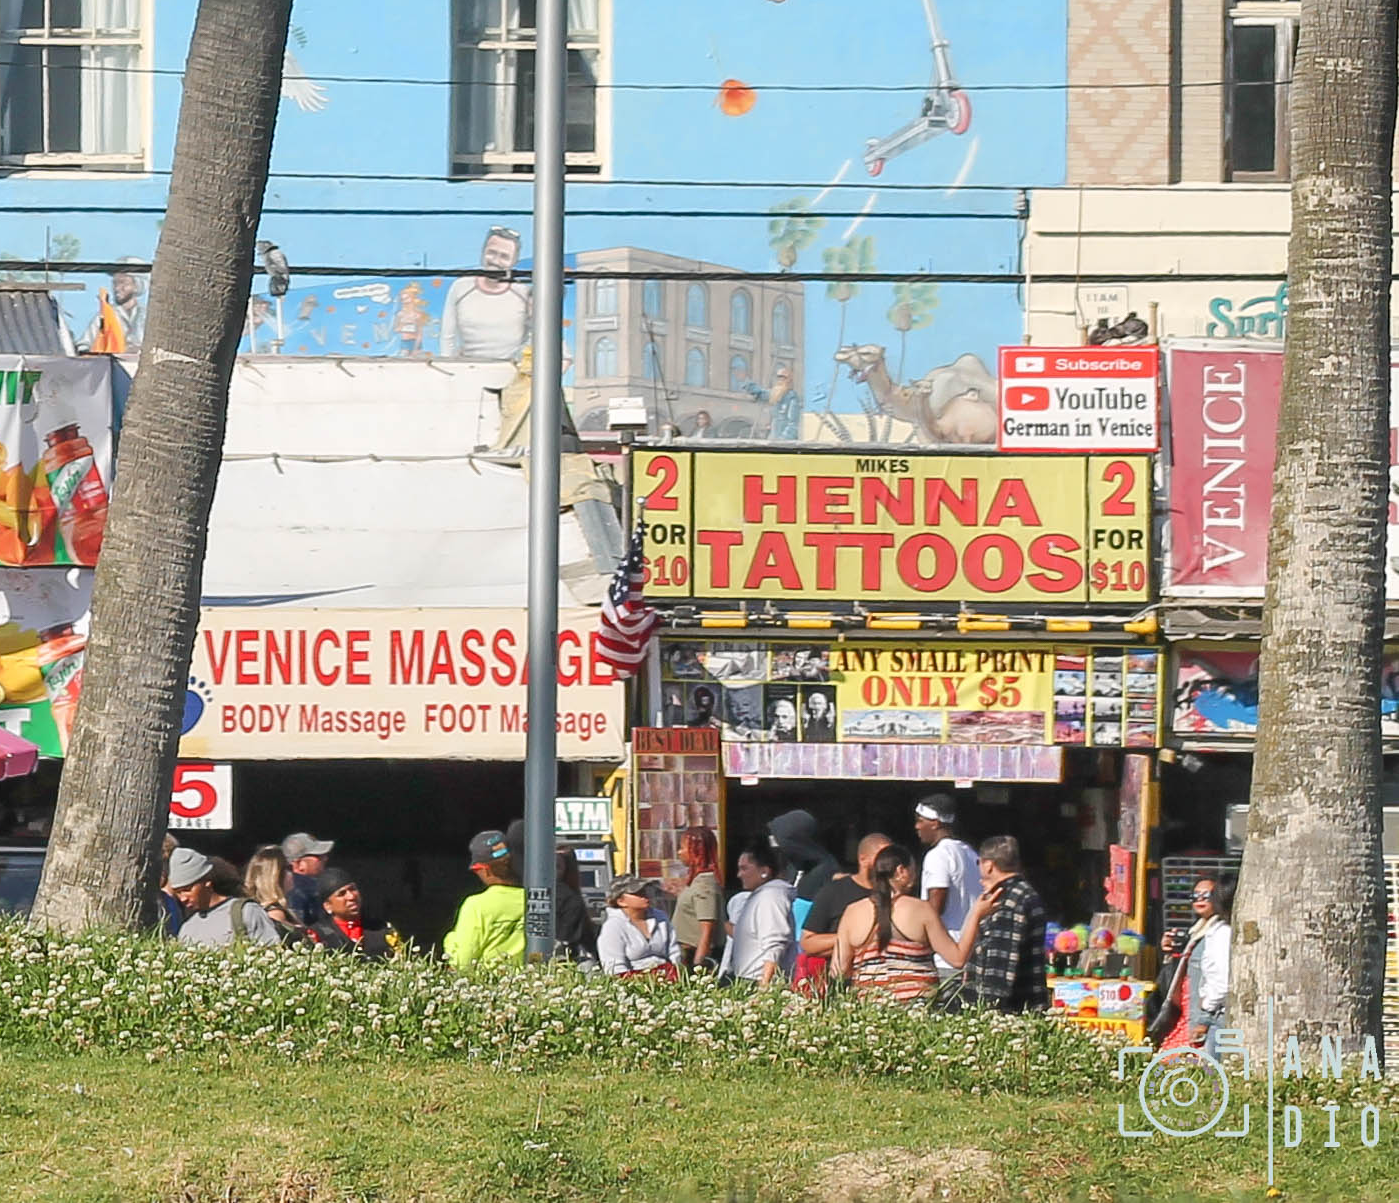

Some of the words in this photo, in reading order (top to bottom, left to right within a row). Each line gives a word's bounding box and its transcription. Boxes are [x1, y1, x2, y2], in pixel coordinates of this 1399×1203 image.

[1055, 358, 1144, 372] Subscribe
[1055, 386, 1147, 411] YouTube
[1004, 417, 1070, 439] German
[1075, 420, 1092, 438] in
[1097, 416, 1153, 438] Venice
[855, 458, 910, 473] MIKES
[1202, 360, 1247, 574] VENICE
[645, 456, 679, 511] 2
[1102, 461, 1136, 516] 2
[742, 475, 1042, 527] HENNA
[1093, 529, 1144, 550] FOR
[697, 530, 1084, 593] TATTOOS
[1090, 561, 1147, 593] $10
[204, 629, 371, 686] VENICE
[390, 629, 615, 686] MASSGE
[832, 647, 884, 674] ANY
[890, 648, 967, 674] SMALL
[975, 648, 1050, 675] PRINT
[861, 675, 965, 708] ONLY
[977, 673, 1022, 710] $5
[221, 704, 291, 734] BODY
[301, 704, 406, 740] Massage
[425, 704, 492, 734] FOOT
[501, 704, 607, 741] Masage
[554, 802, 609, 832] ATM
